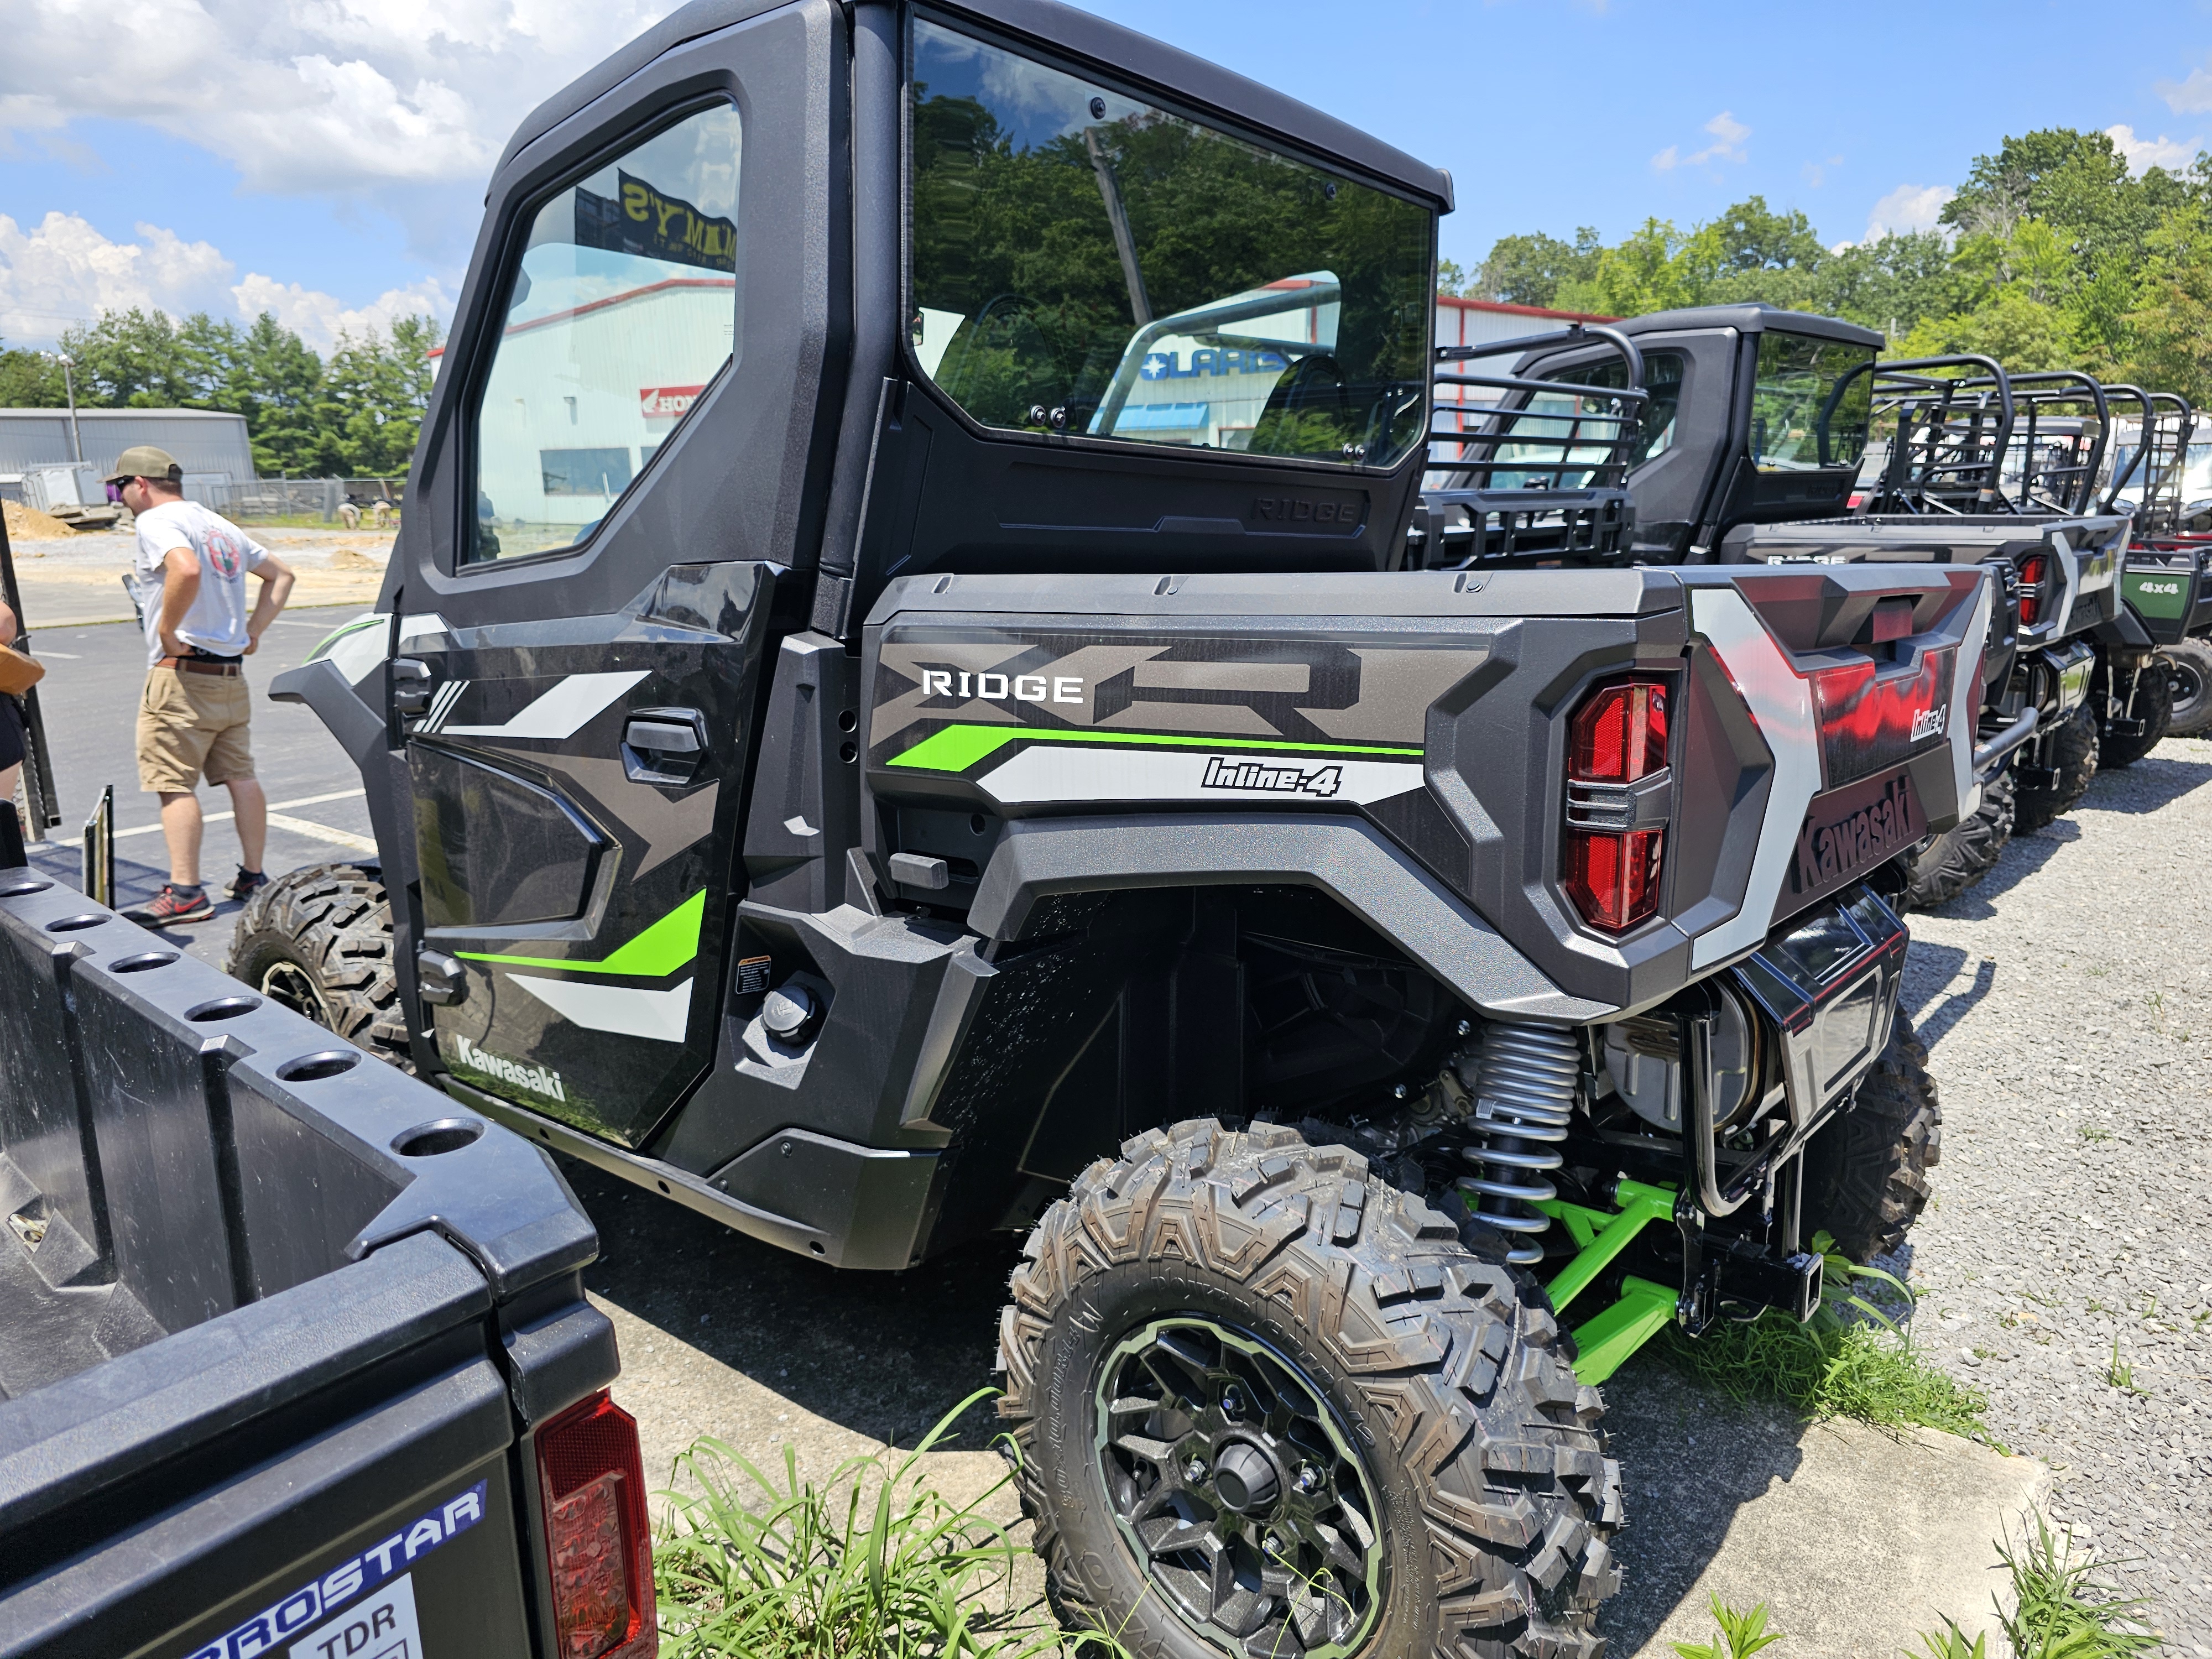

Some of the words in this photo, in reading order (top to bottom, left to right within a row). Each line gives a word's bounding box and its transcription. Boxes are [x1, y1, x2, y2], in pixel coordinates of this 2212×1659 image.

[1251, 498, 1357, 523] RIDGE
[2139, 582, 2179, 594] 4x4
[922, 669, 1084, 704] RIDGE
[1910, 703, 1947, 743] Inline-4
[1201, 757, 1344, 797] Inline-4
[1792, 775, 1915, 894] Kawasaki
[455, 1033, 566, 1102] Kawasaki
[1150, 1275, 1251, 1315] POWER
[1261, 1318, 1334, 1389] GRIP
[1048, 1326, 1082, 1509] 30x10.00R14
[317, 1603, 397, 1659] TDR
